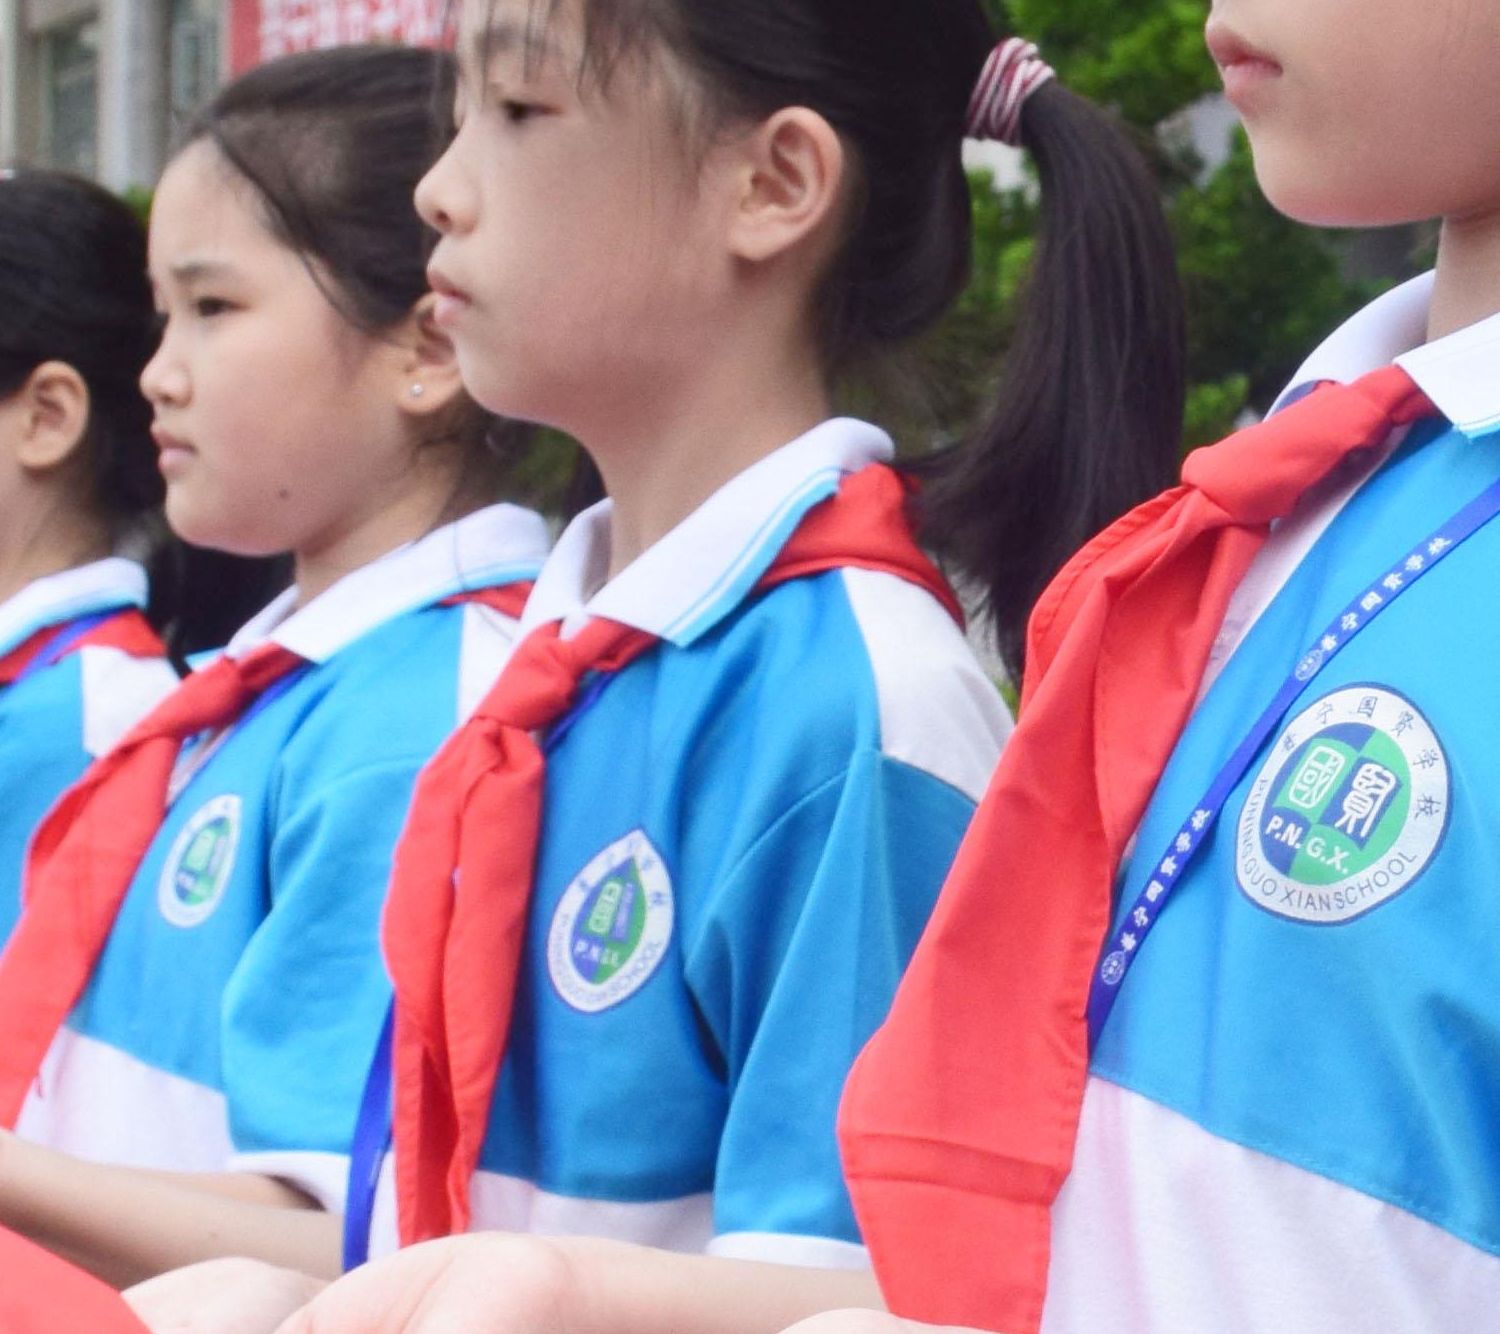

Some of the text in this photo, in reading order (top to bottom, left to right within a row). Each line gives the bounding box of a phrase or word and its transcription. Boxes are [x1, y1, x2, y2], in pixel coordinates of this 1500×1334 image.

[1243, 857, 1278, 898] GUO
[1279, 884, 1332, 912] XIAN
[1336, 849, 1418, 910] SCHOOL
